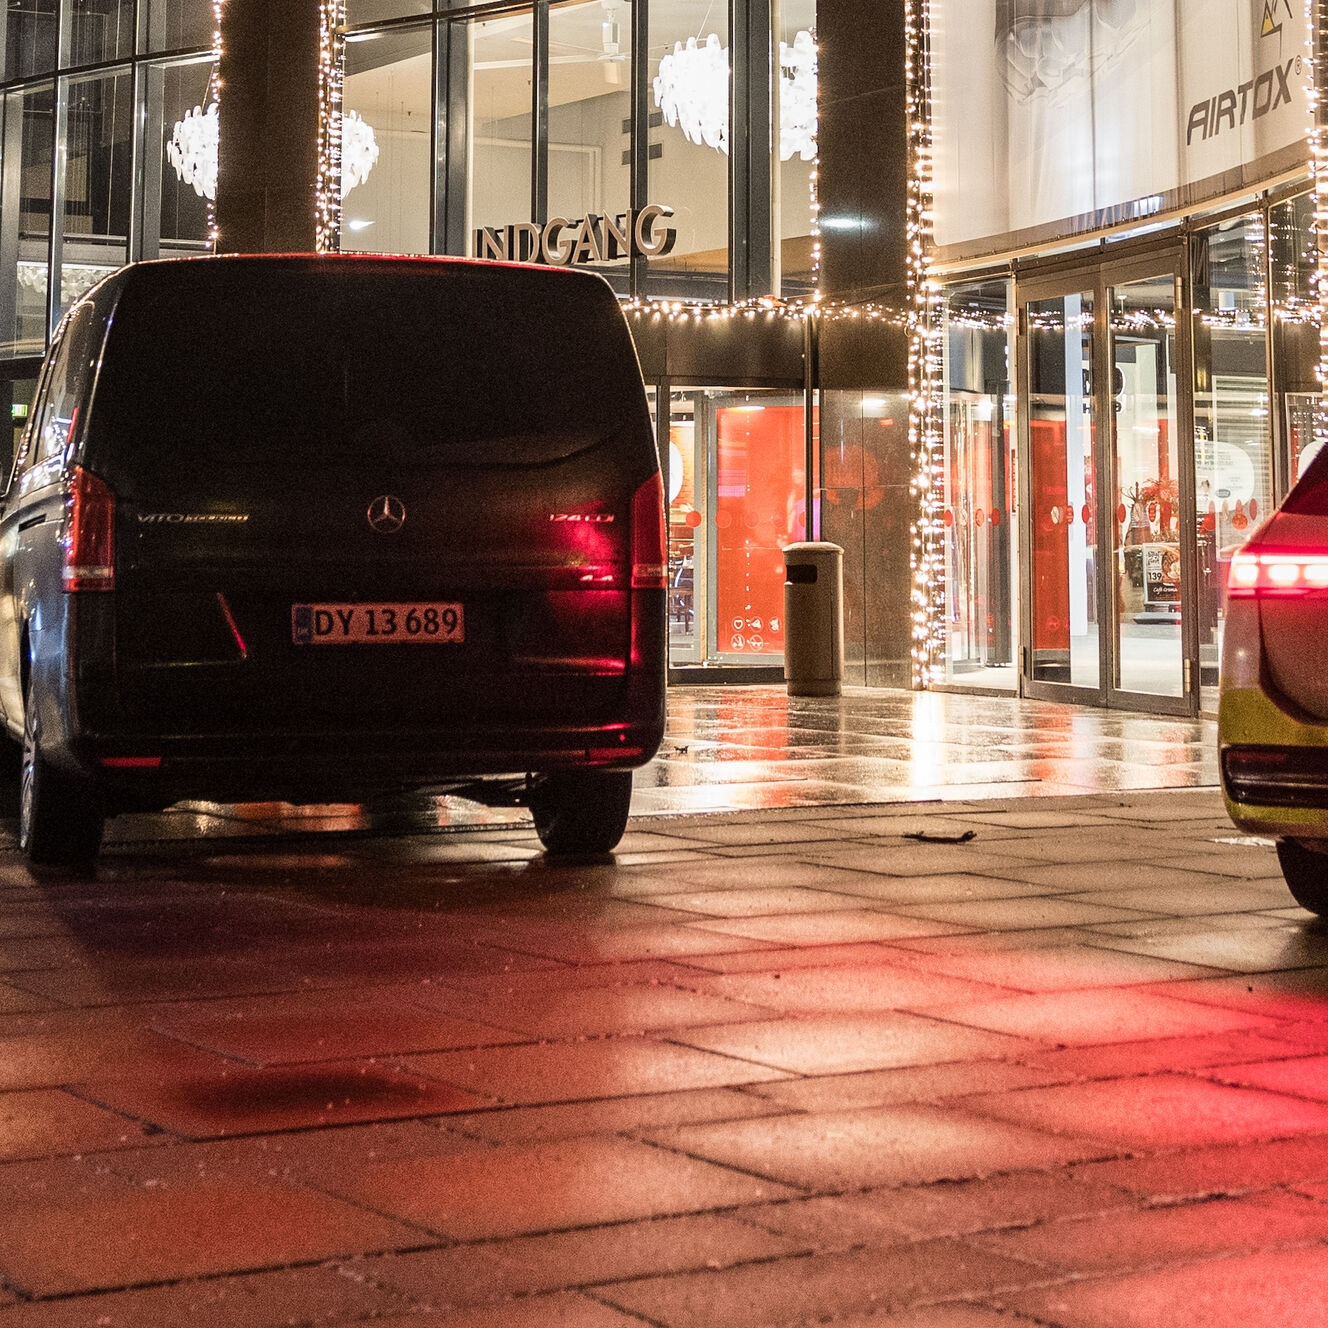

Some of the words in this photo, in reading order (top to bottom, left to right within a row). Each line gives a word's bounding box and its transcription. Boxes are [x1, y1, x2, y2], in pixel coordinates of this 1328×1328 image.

[473, 204, 676, 266] INDGANG
[1147, 572, 1162, 581] 139
[315, 609, 354, 636] DY
[365, 608, 397, 636] 13
[405, 607, 458, 635] 689
